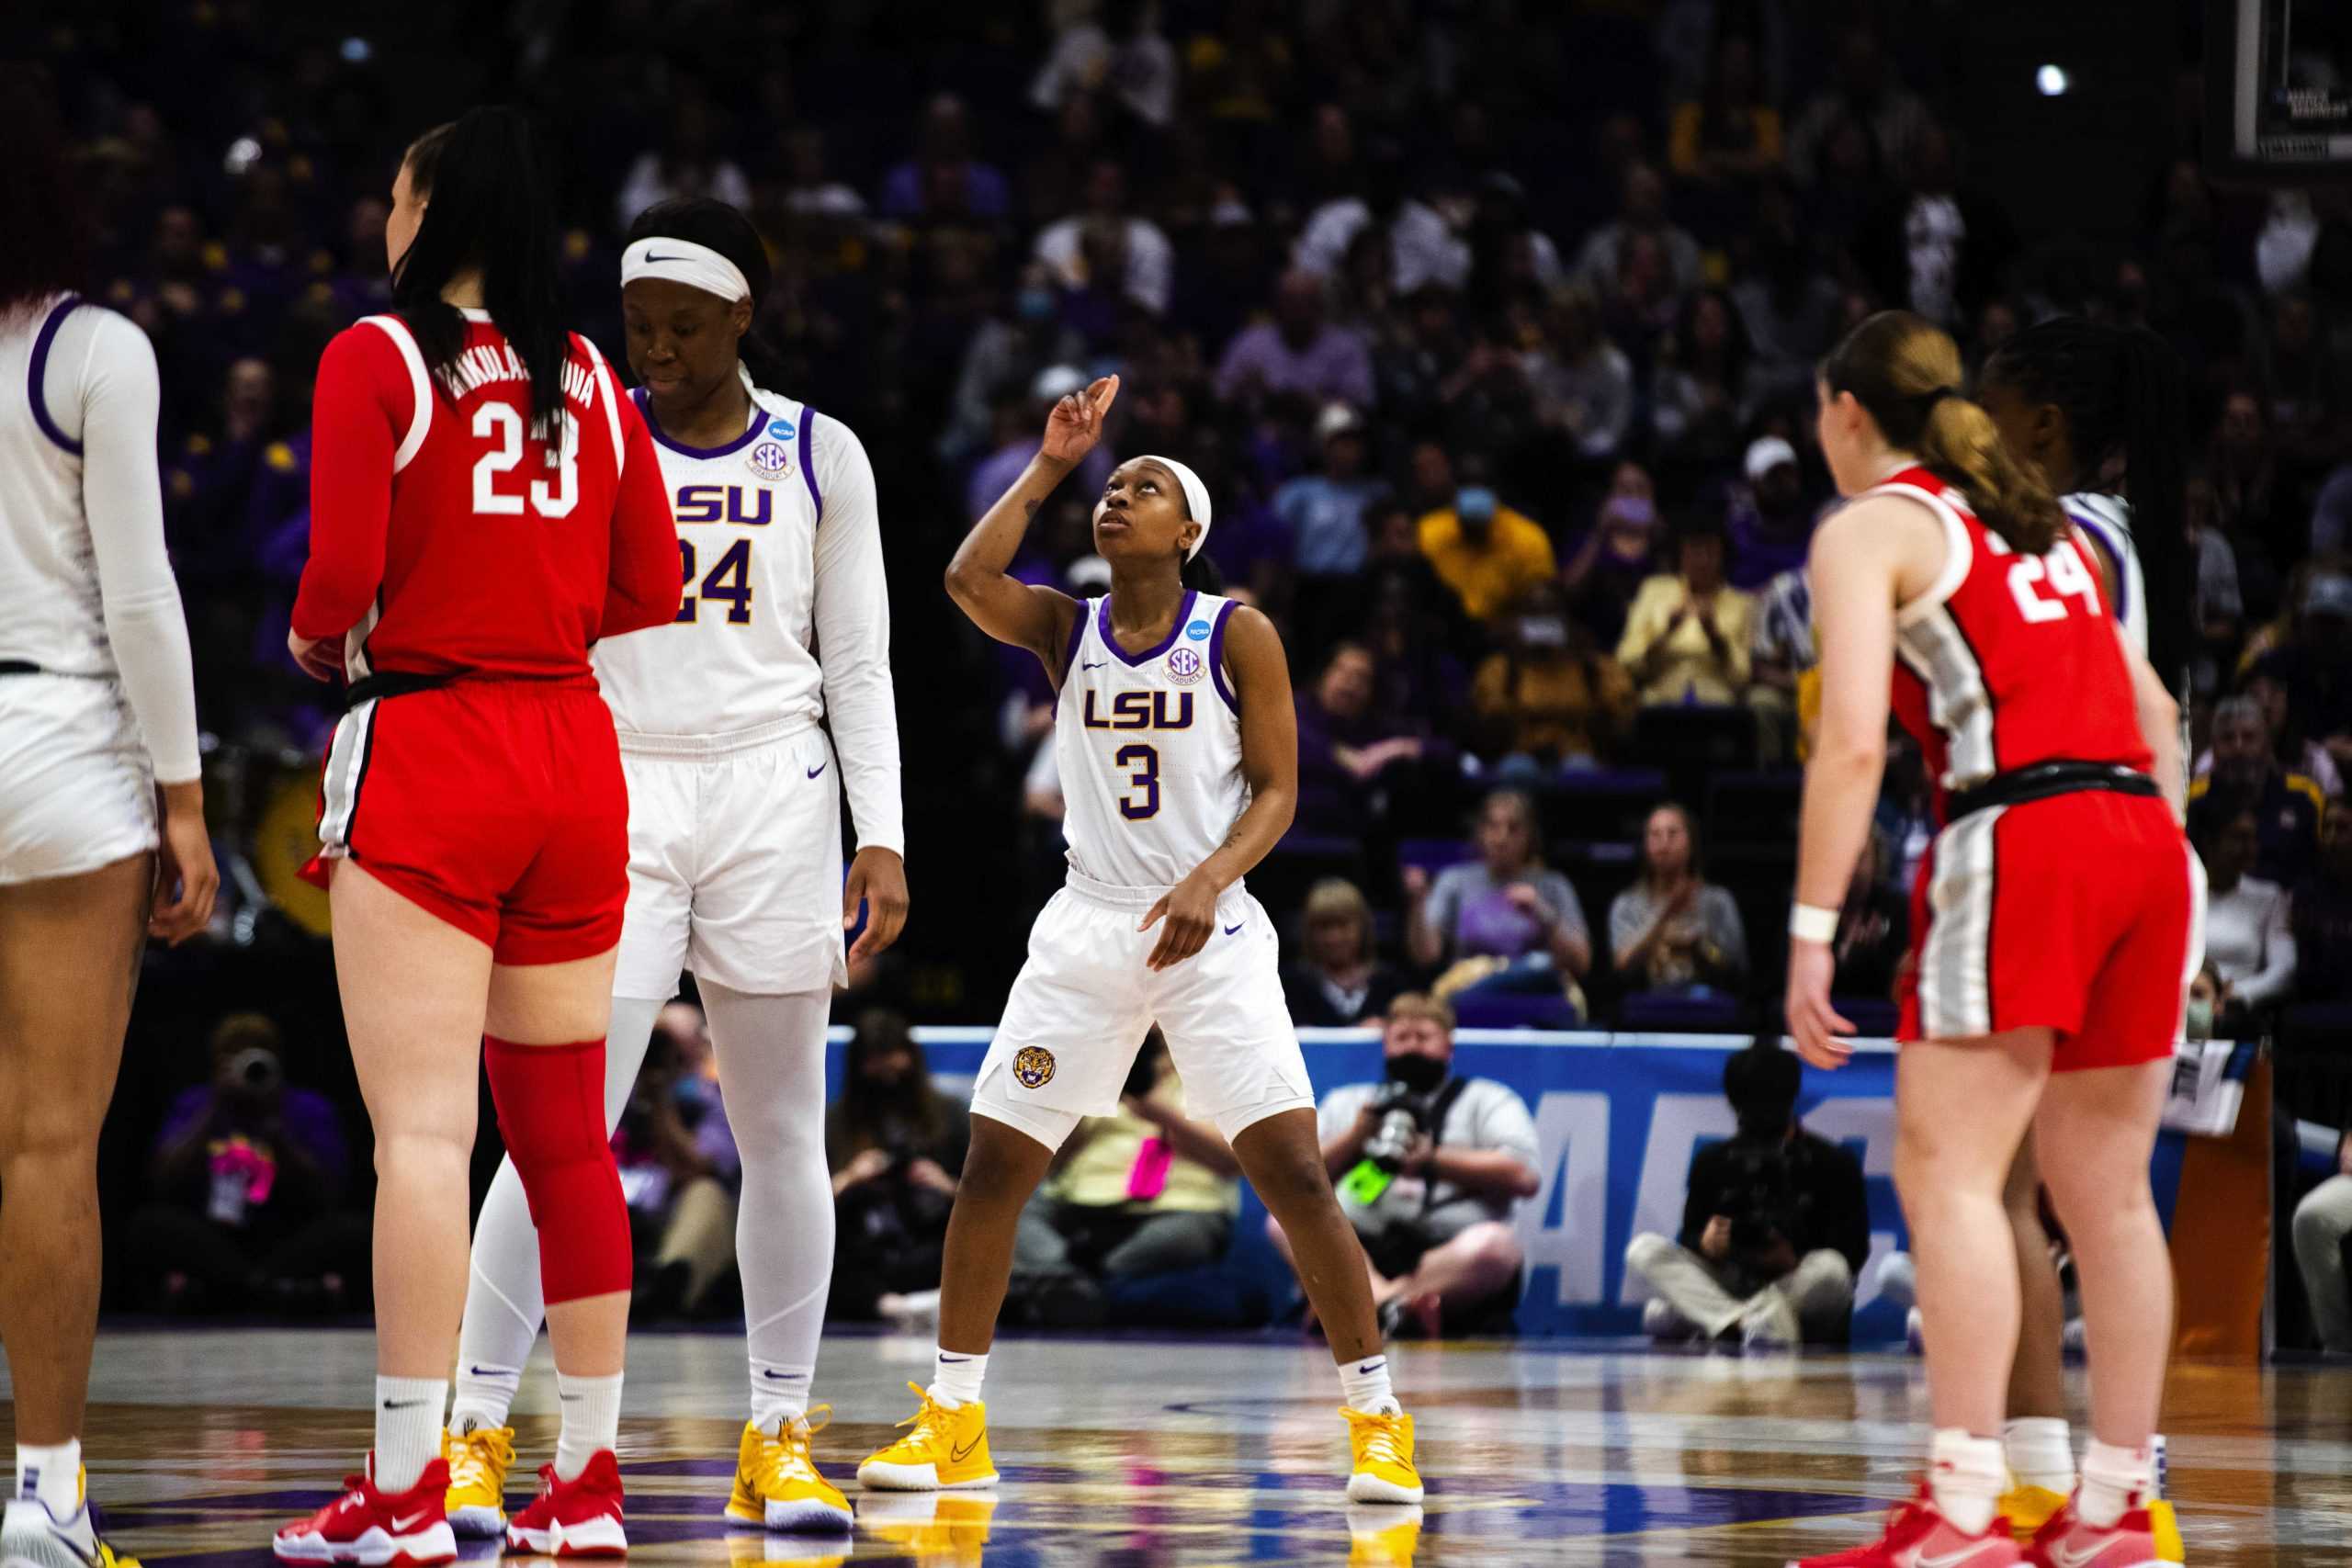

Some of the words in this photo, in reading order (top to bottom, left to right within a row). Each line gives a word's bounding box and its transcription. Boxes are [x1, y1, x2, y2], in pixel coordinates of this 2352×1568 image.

[471, 400, 580, 520] 23
[754, 444, 786, 470] SEC
[675, 484, 774, 526] SU
[2007, 535, 2103, 625] 24
[1170, 649, 1199, 676] SEC
[1084, 689, 1193, 730] LSU
[1115, 744, 1160, 821] 3
